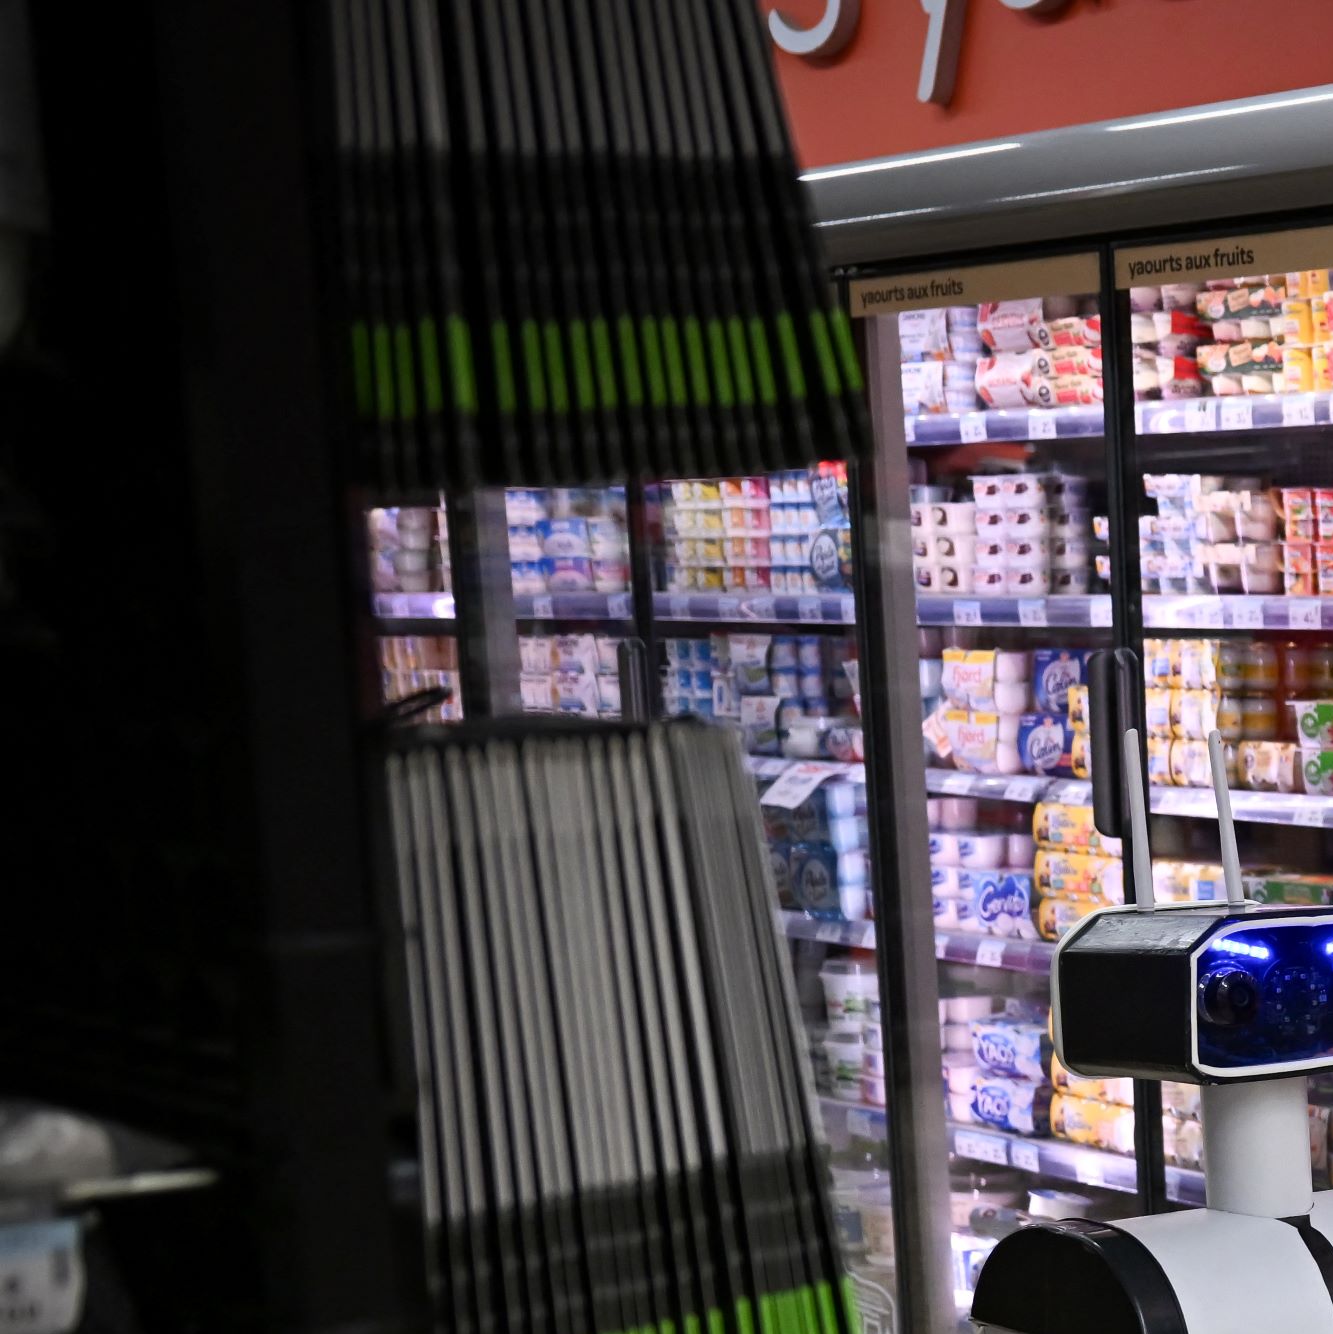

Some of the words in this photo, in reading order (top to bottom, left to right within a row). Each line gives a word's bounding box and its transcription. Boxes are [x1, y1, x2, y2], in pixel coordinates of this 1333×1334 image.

[1128, 255, 1182, 280] yaourts
[1184, 254, 1211, 271] aux
[1213, 246, 1254, 268] fruits
[860, 282, 904, 308] yaourts
[907, 284, 928, 299] aux
[930, 277, 963, 298] fruits
[950, 664, 982, 687] fjord
[956, 725, 985, 747] fjord
